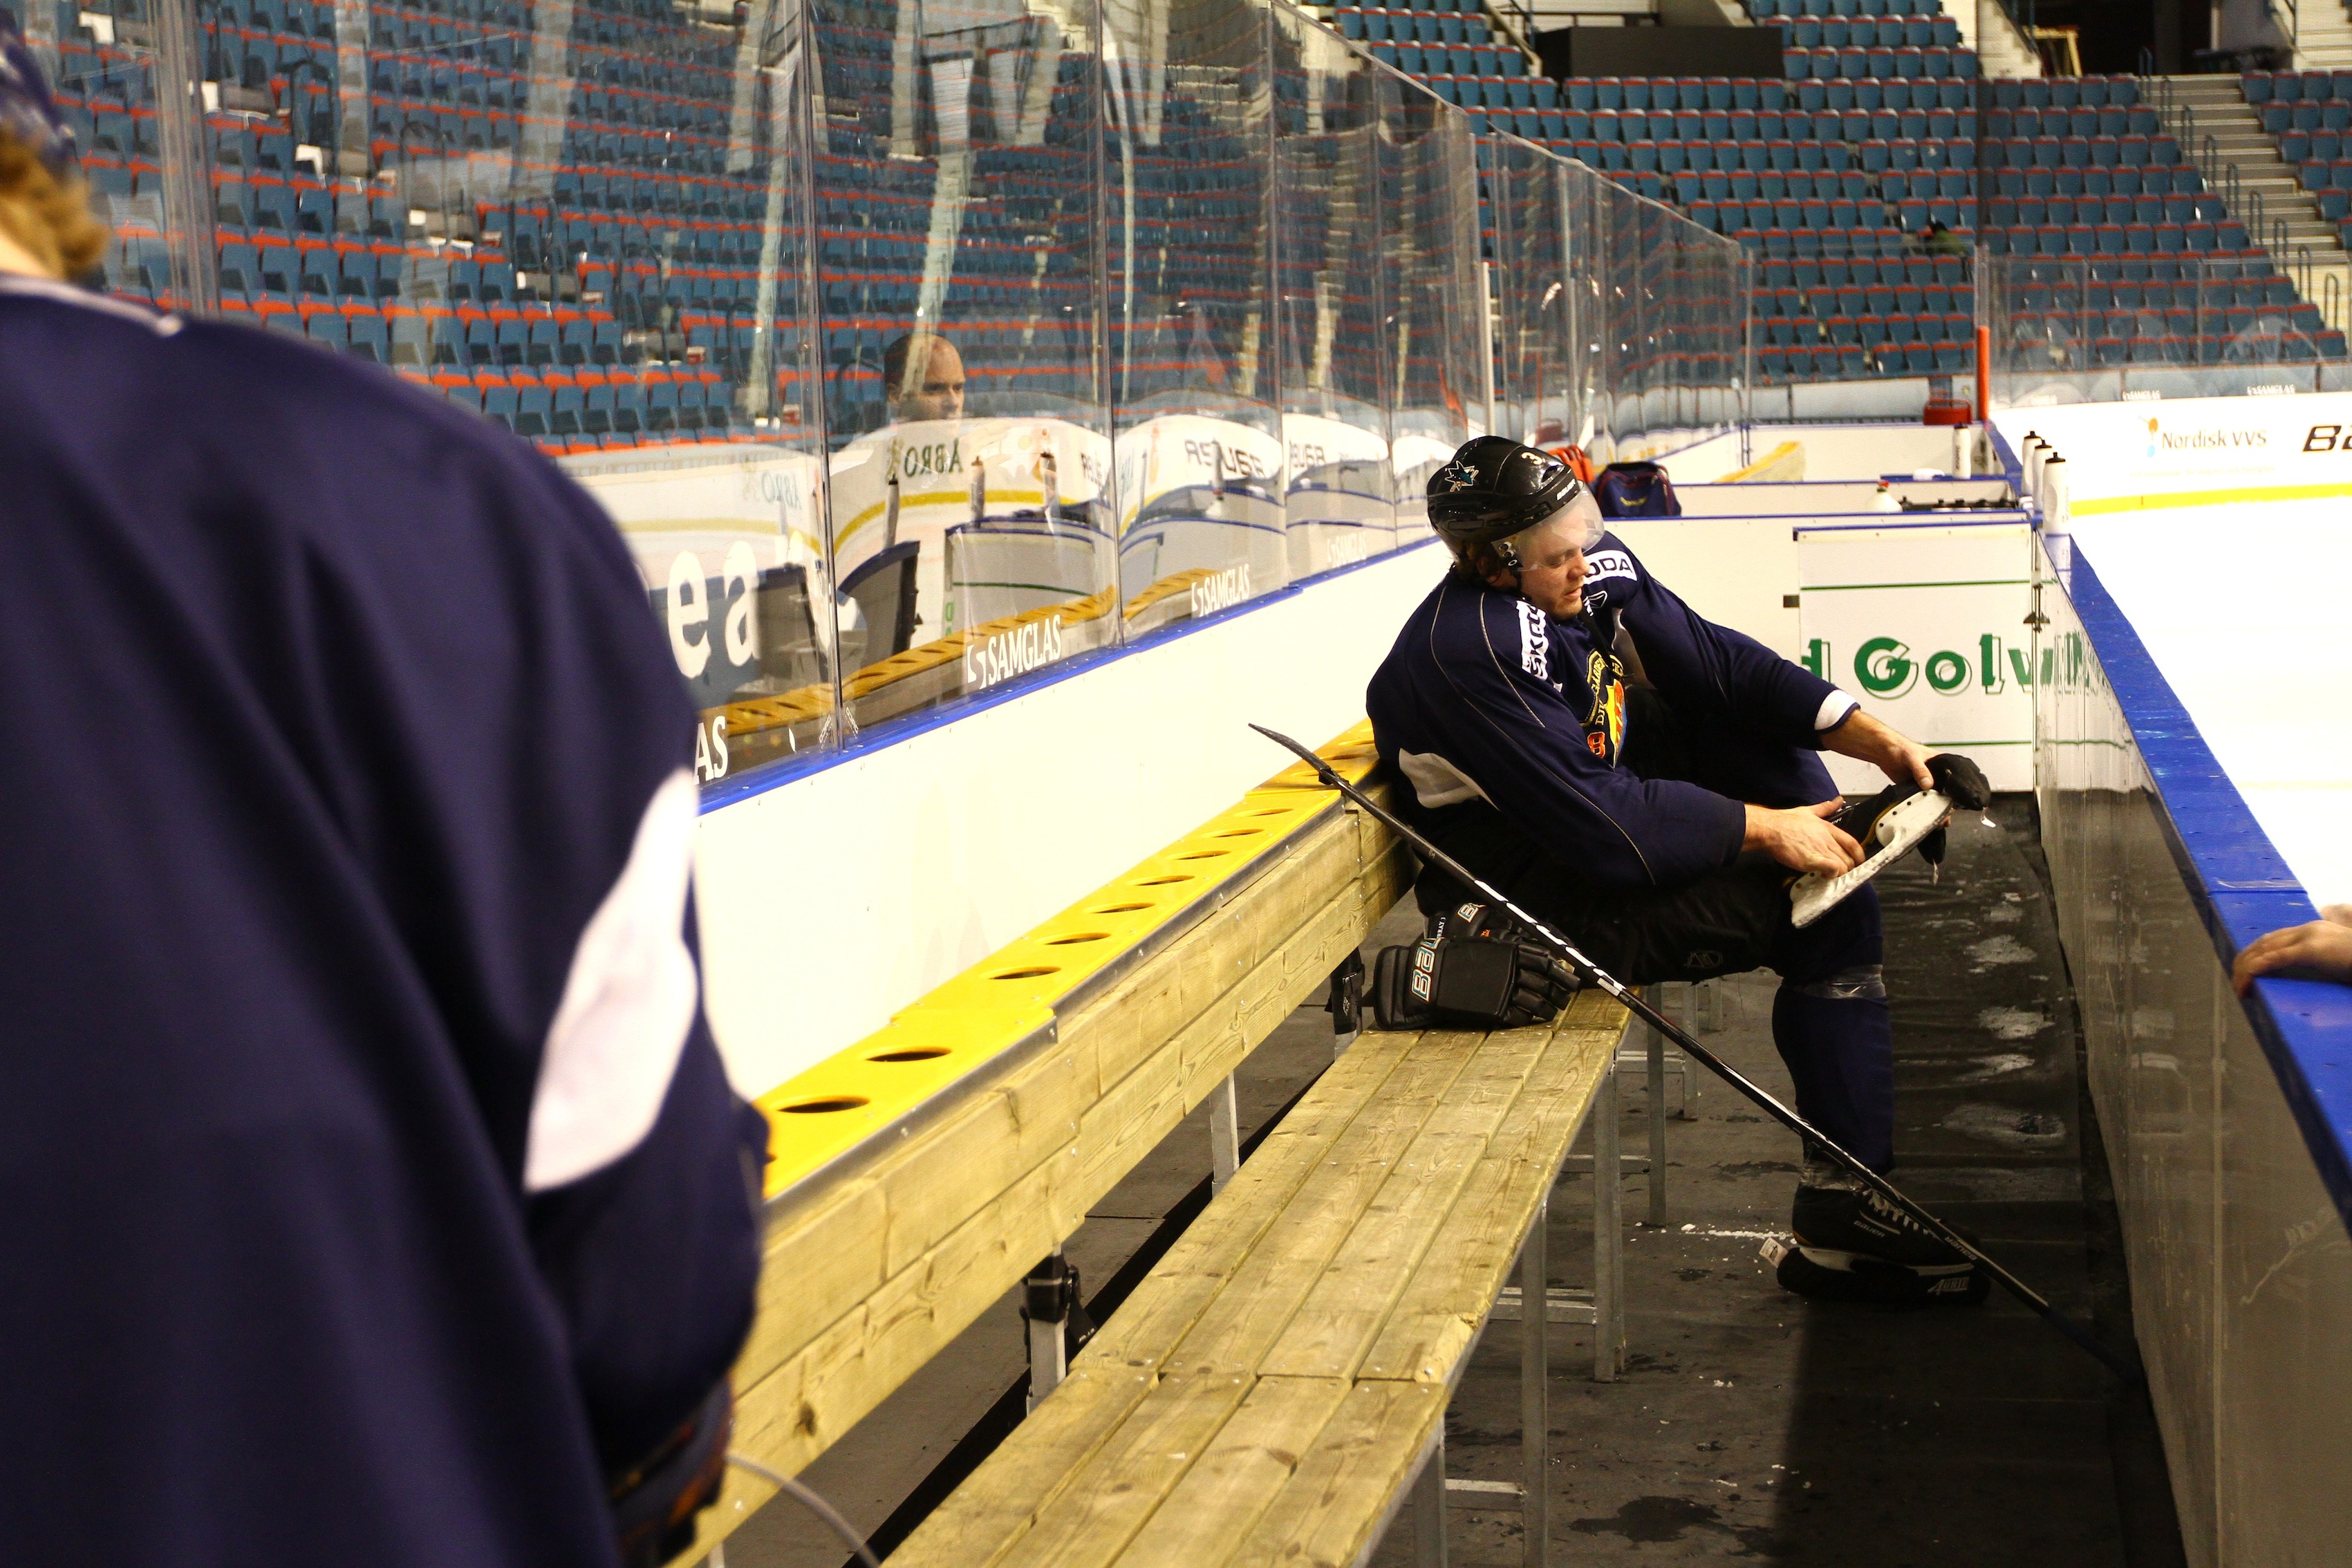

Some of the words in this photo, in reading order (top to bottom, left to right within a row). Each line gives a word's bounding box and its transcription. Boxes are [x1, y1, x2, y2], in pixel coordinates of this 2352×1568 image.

[1520, 451, 1543, 465] 3
[2162, 429, 2227, 451] Nordisk
[2232, 429, 2268, 447] VVS
[1203, 563, 1250, 616] SAMGLAS
[1585, 557, 1634, 578] ODA
[987, 615, 1061, 685] SAMGLAS
[693, 715, 728, 785] AS
[1410, 937, 1443, 1002] BAU
